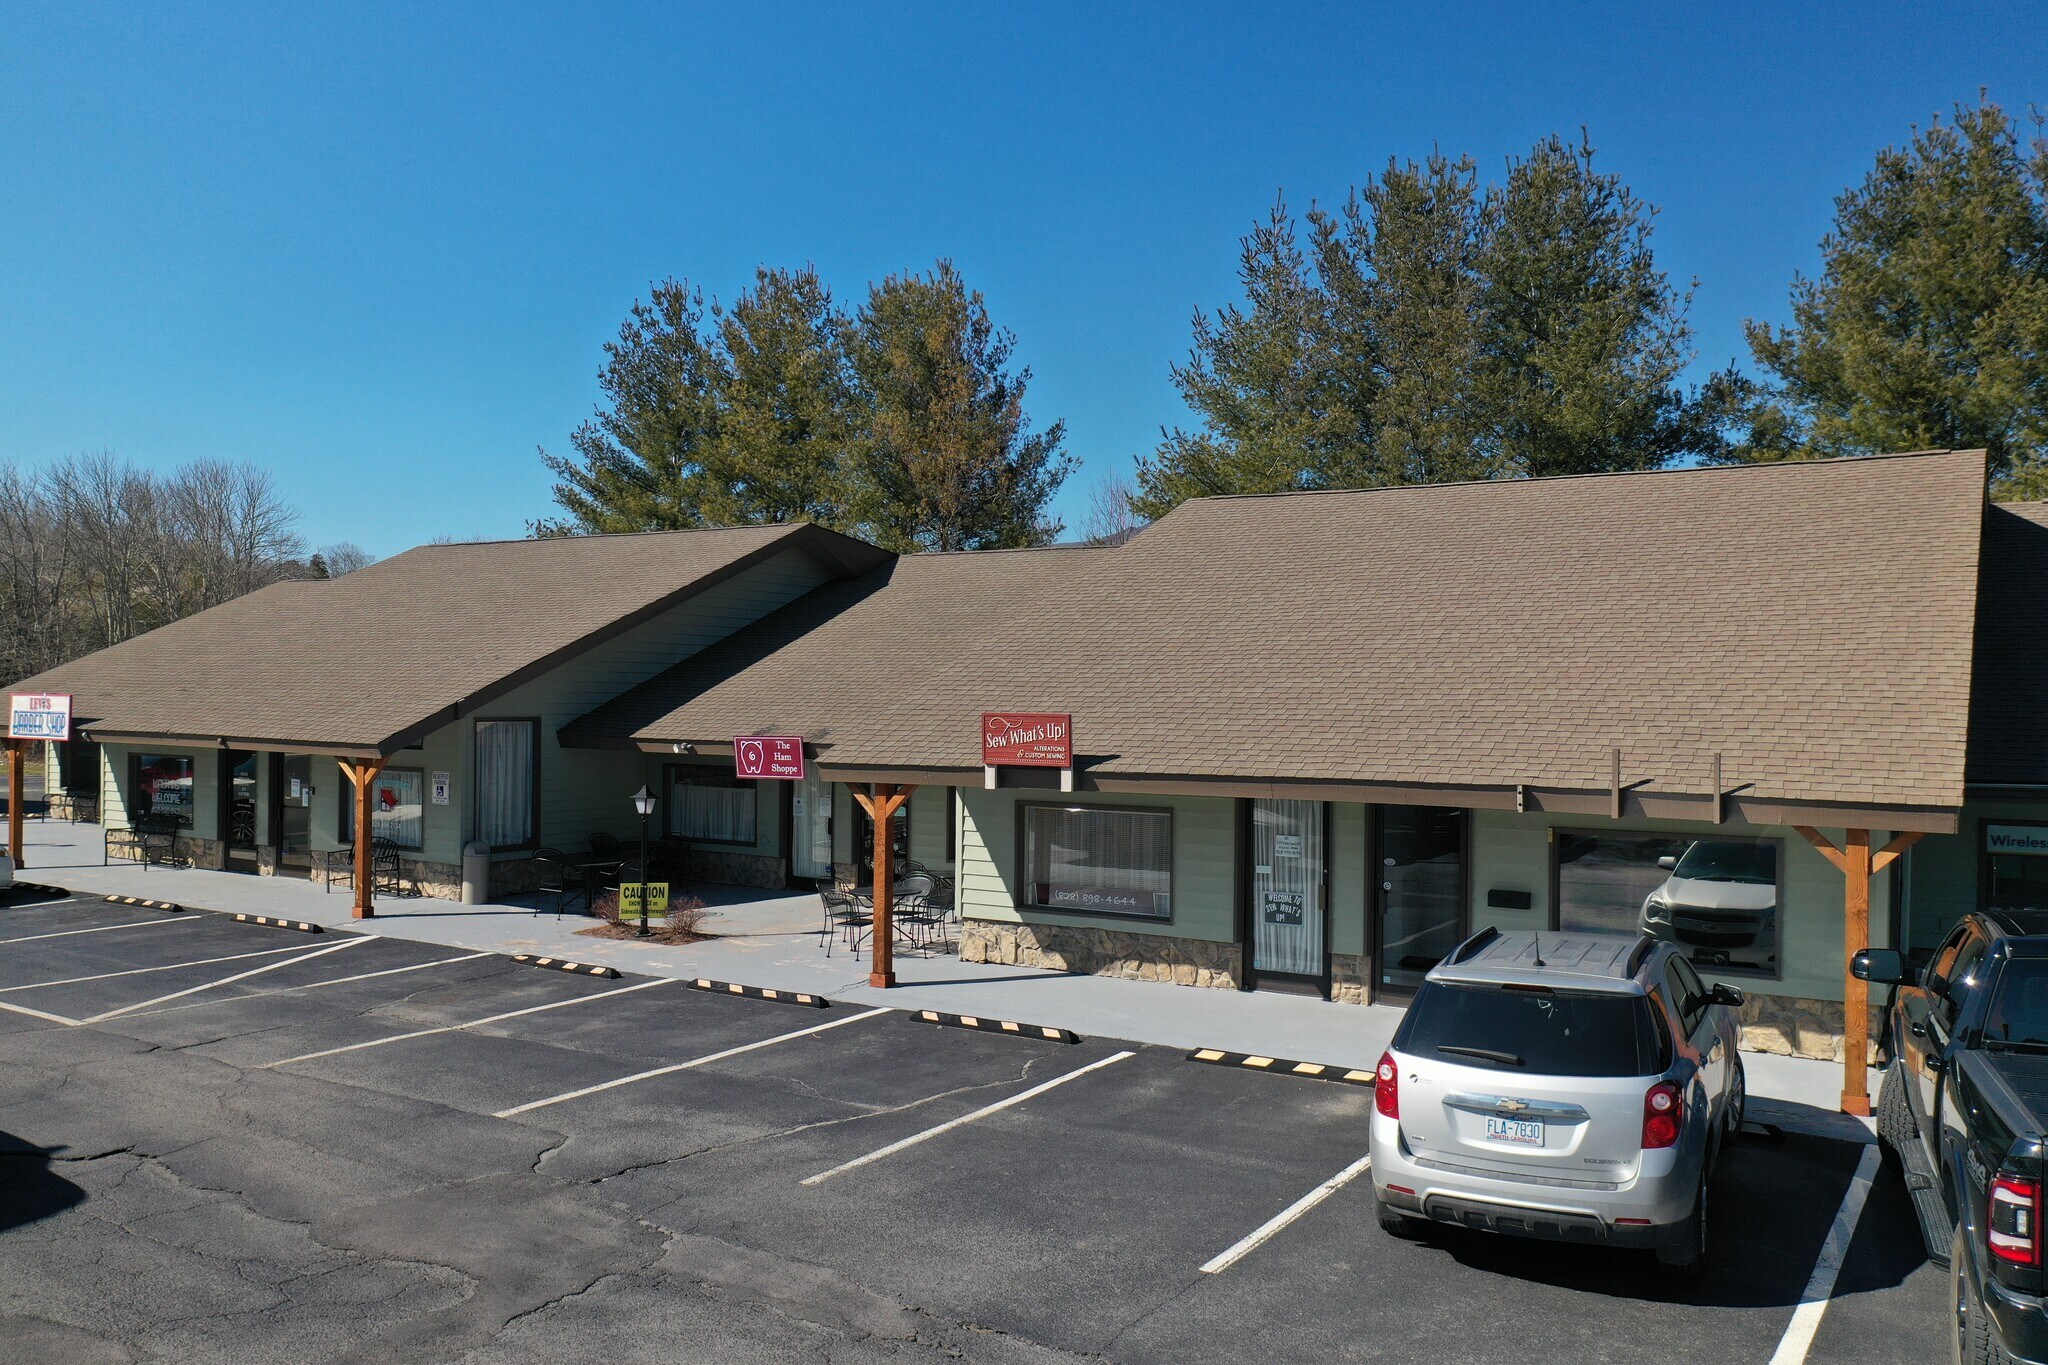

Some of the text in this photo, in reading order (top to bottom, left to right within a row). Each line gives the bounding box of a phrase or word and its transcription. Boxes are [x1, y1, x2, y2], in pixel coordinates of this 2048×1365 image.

[13, 710, 66, 737] BARBER SHOP
[986, 722, 1065, 748] Sew What's Up!
[775, 740, 791, 749] The
[774, 752, 792, 761] Ham
[771, 763, 798, 775] Shoppe
[152, 792, 181, 804] WELCOME
[1990, 834, 2048, 848] Wireles
[623, 886, 665, 899] CAUION
[1054, 889, 1137, 907] (828) 898-4644
[1268, 893, 1302, 905] WELCOME TO
[1487, 1119, 1540, 1139] FLA-7830
[1510, 1136, 1537, 1144] CAROLINA
